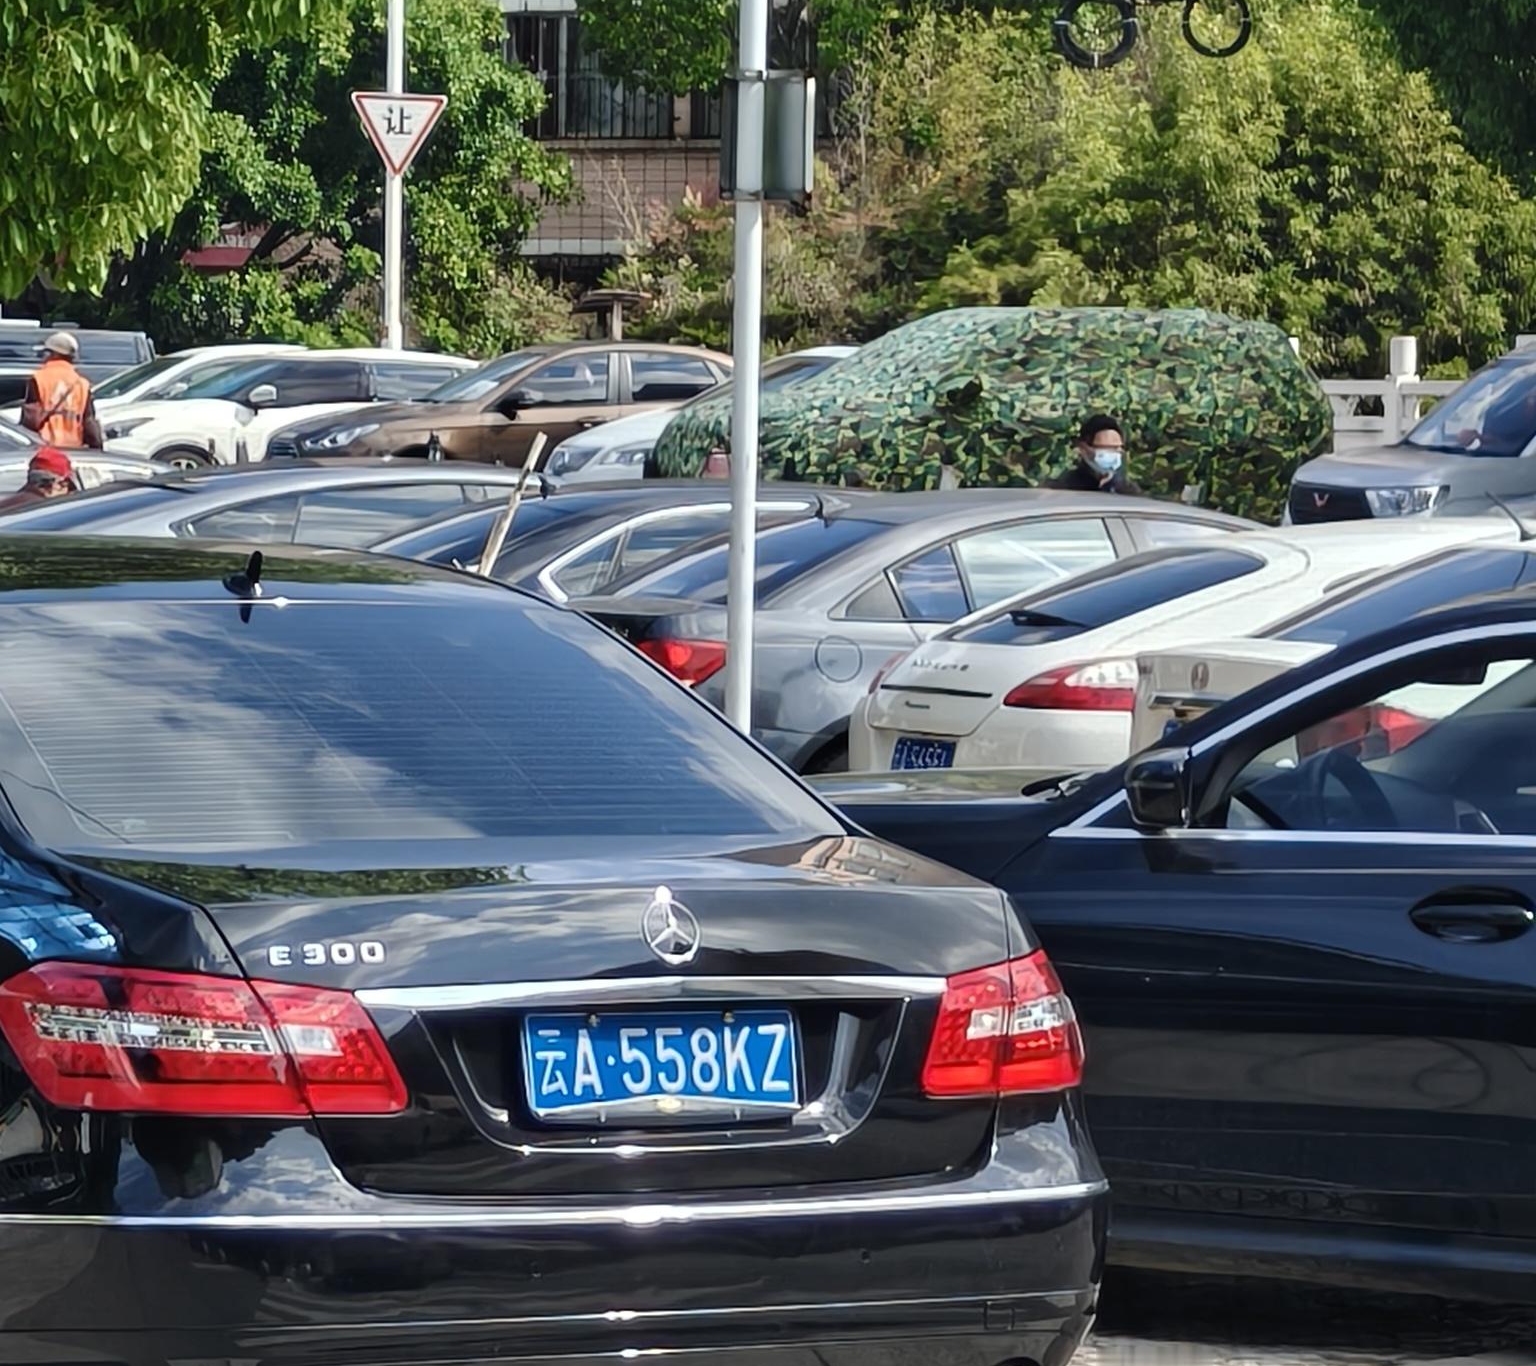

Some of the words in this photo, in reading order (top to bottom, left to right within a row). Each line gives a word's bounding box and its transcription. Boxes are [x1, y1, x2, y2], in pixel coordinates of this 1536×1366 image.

[383, 105, 413, 135] 让
[268, 945, 293, 967] E
[302, 940, 385, 966] 300
